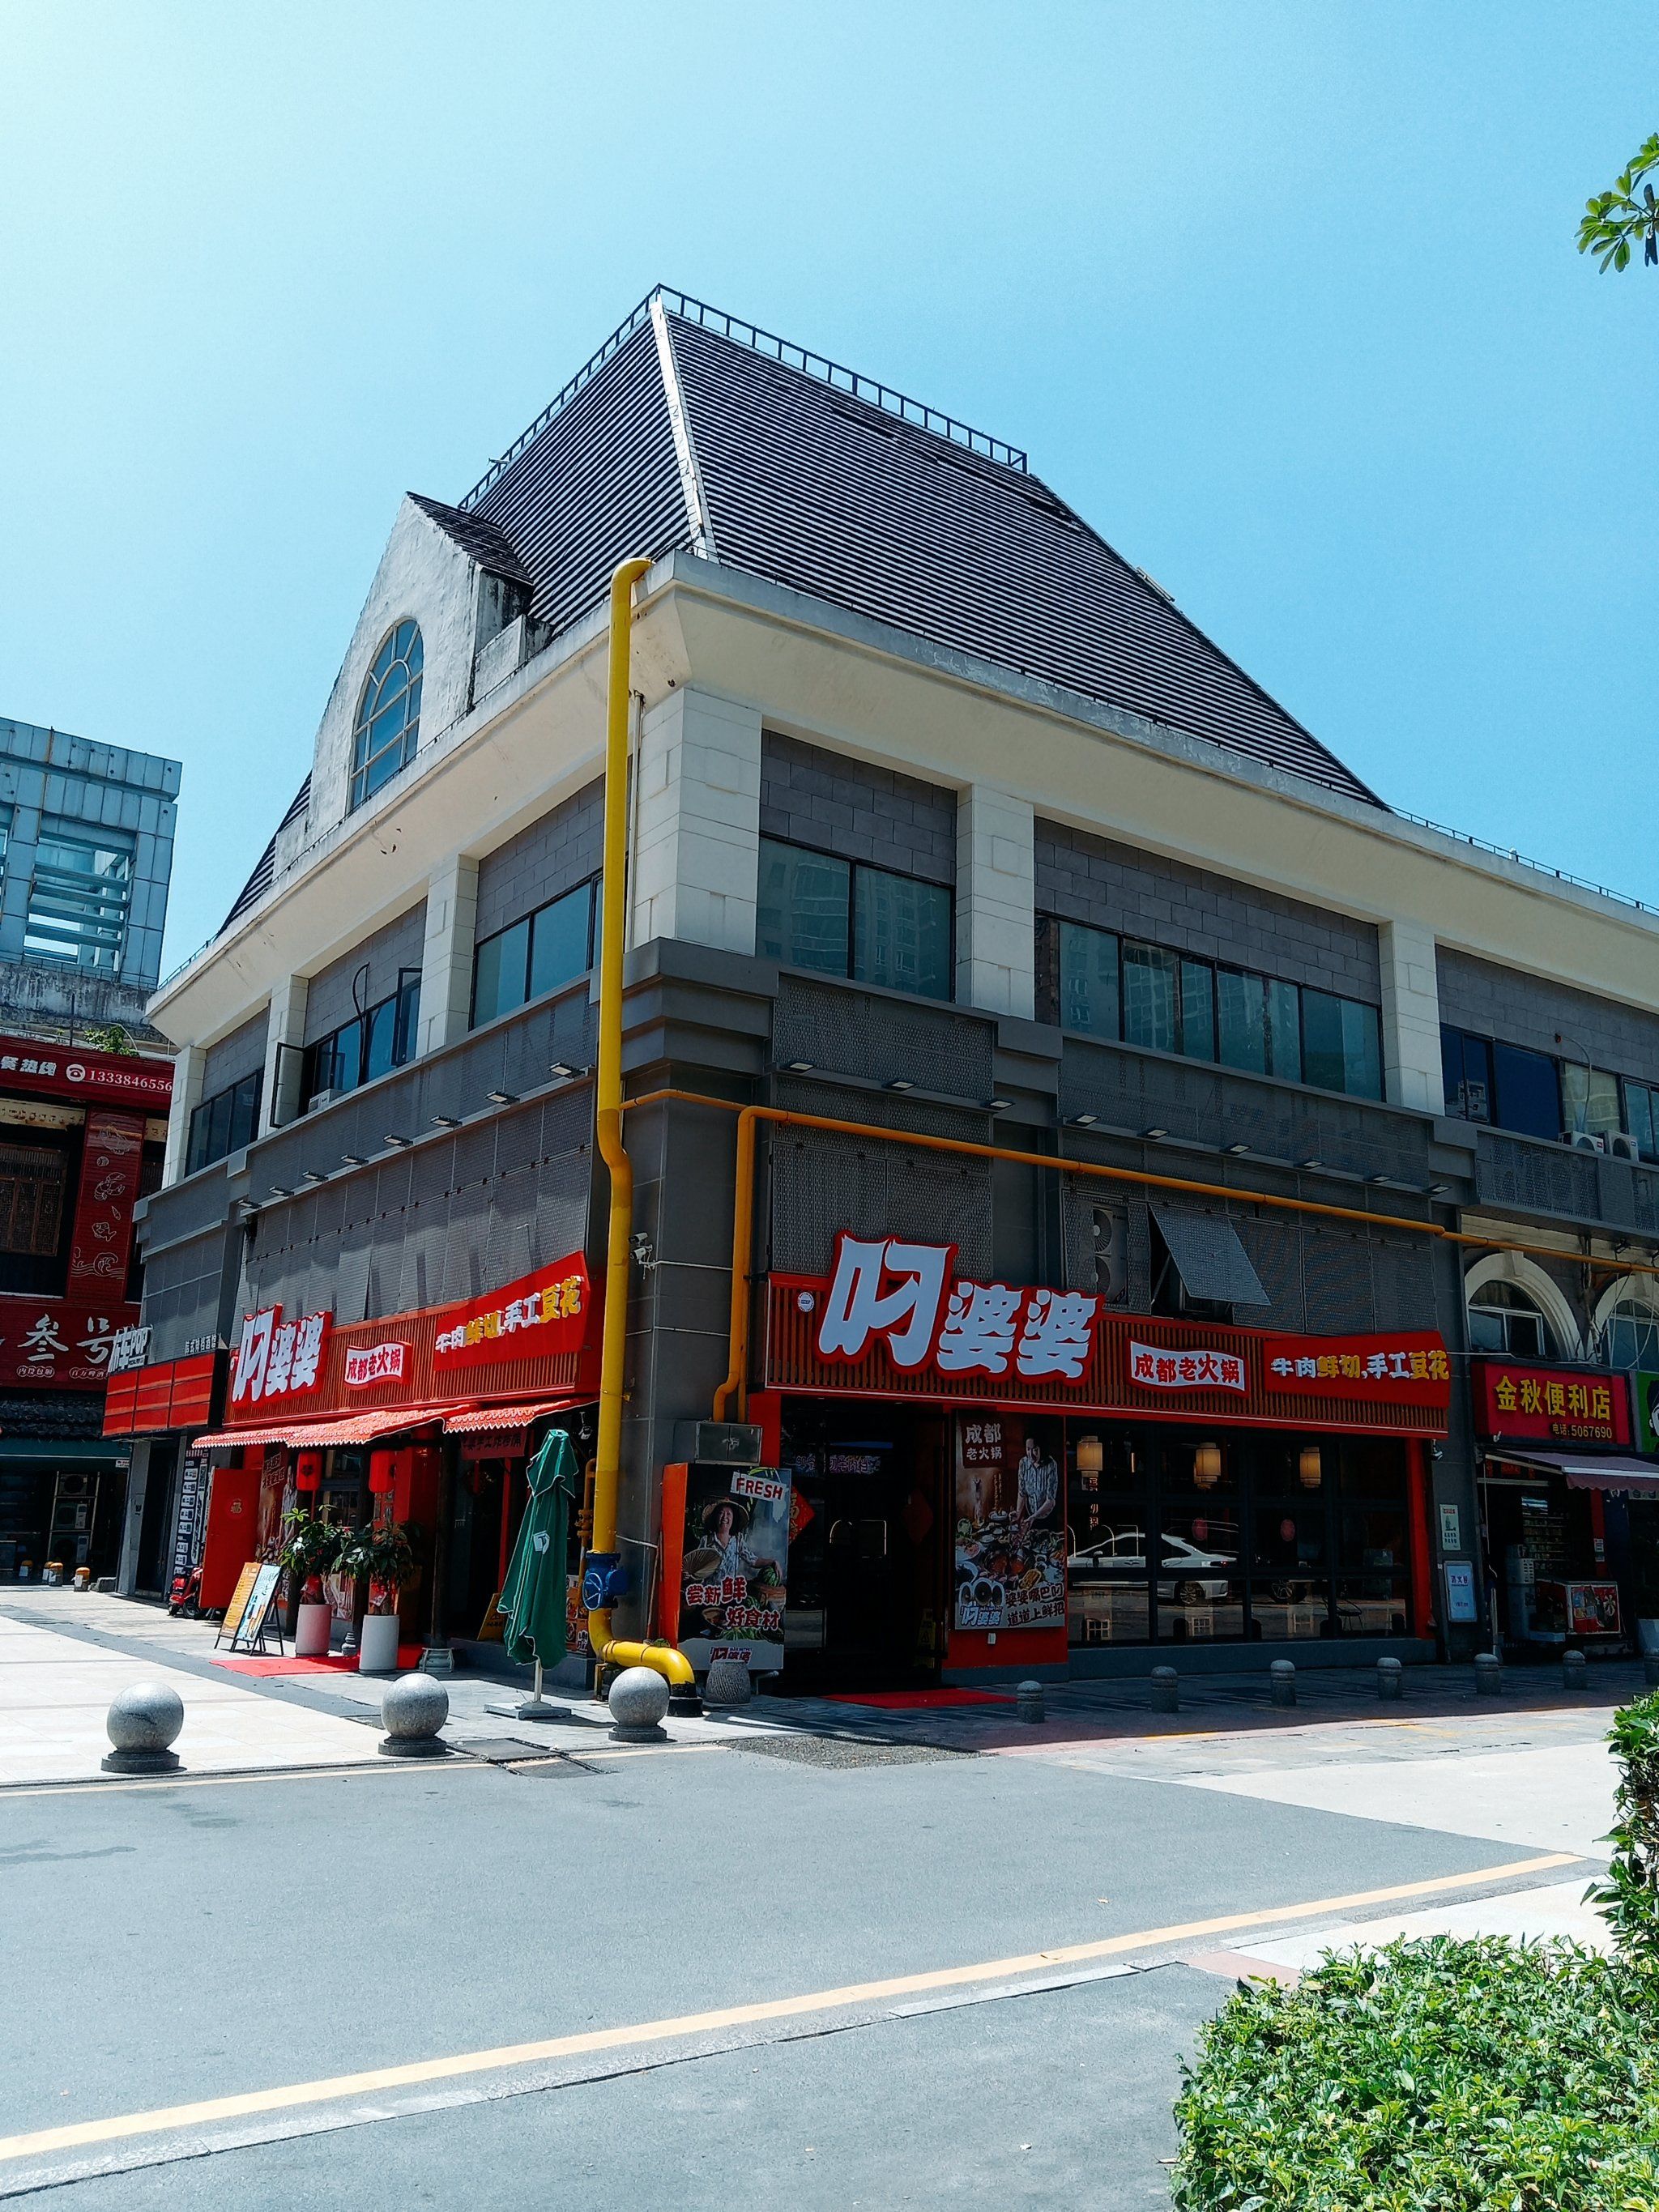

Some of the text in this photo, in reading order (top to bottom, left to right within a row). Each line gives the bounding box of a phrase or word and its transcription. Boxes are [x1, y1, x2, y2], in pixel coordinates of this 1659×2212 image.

[89, 1070, 173, 1092] 1333846556
[819, 1235, 1097, 1378] 叼婆婆
[0, 1314, 117, 1364] 叁号
[347, 1346, 401, 1382] 成都老火锅
[1134, 1353, 1240, 1384] 成都老火锅
[1495, 1375, 1610, 1421] 金秋便利店
[966, 1423, 1001, 1444] 成都
[966, 1446, 1002, 1461] 老火锅
[736, 1477, 783, 1500] FRESH
[726, 1605, 780, 1630] 好食材
